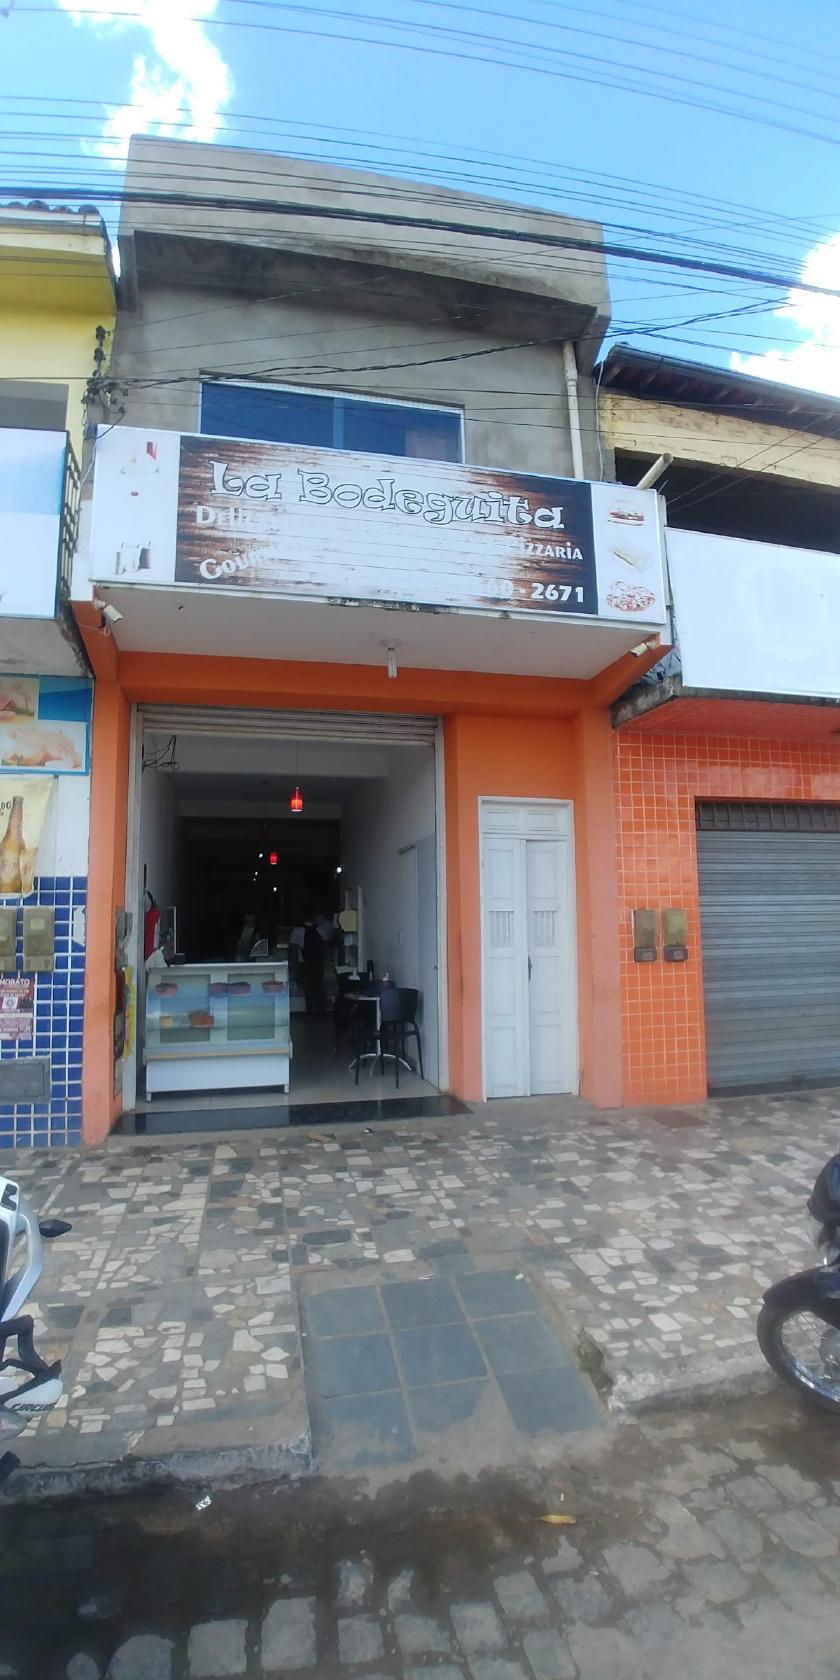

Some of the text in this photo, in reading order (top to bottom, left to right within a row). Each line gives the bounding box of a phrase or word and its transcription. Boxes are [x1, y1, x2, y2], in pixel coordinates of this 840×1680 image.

[209, 460, 565, 529] La Bodeguita
[531, 582, 585, 603] 2671
